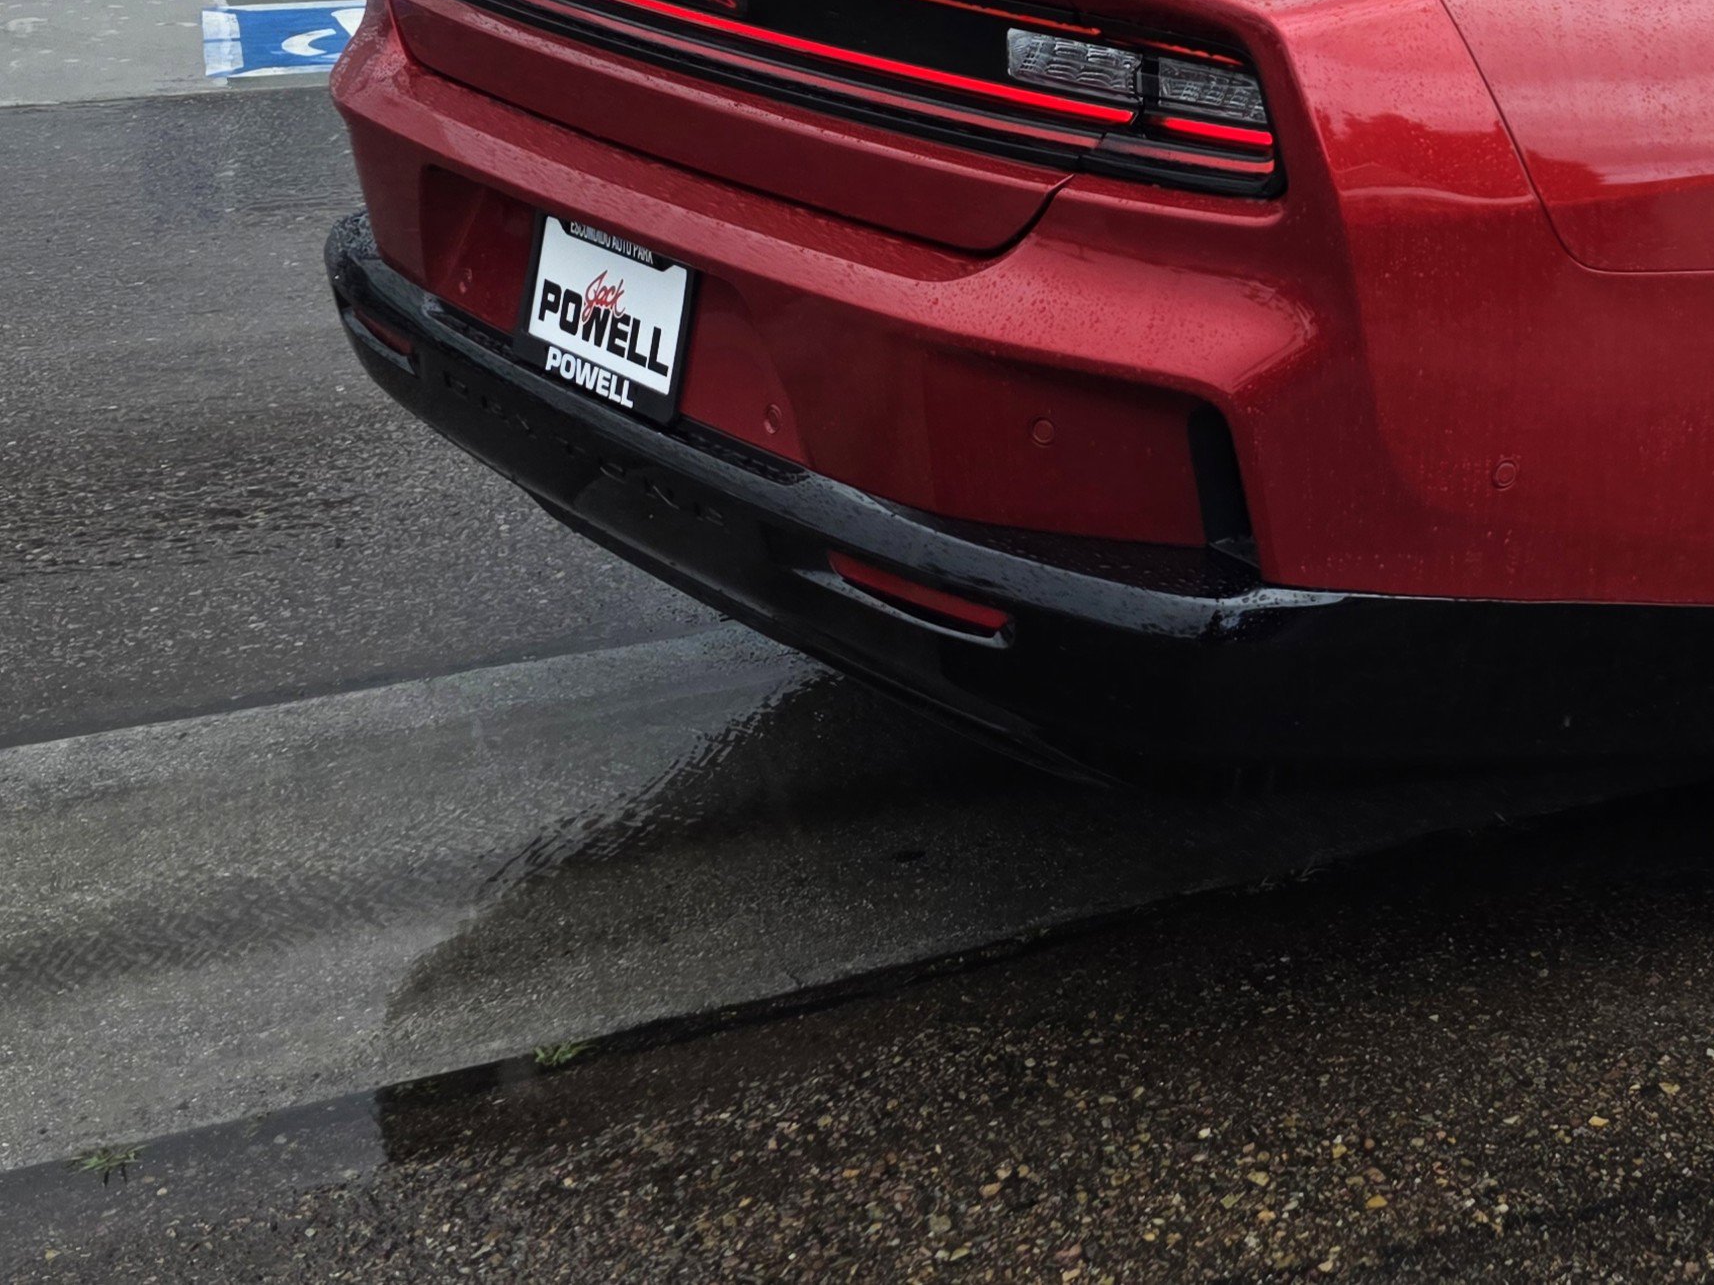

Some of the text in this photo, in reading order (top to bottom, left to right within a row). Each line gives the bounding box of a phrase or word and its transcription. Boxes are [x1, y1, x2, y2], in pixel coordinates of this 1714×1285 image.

[538, 278, 669, 378] POWELL
[581, 269, 626, 323] Jack
[545, 345, 634, 409] POWELL
